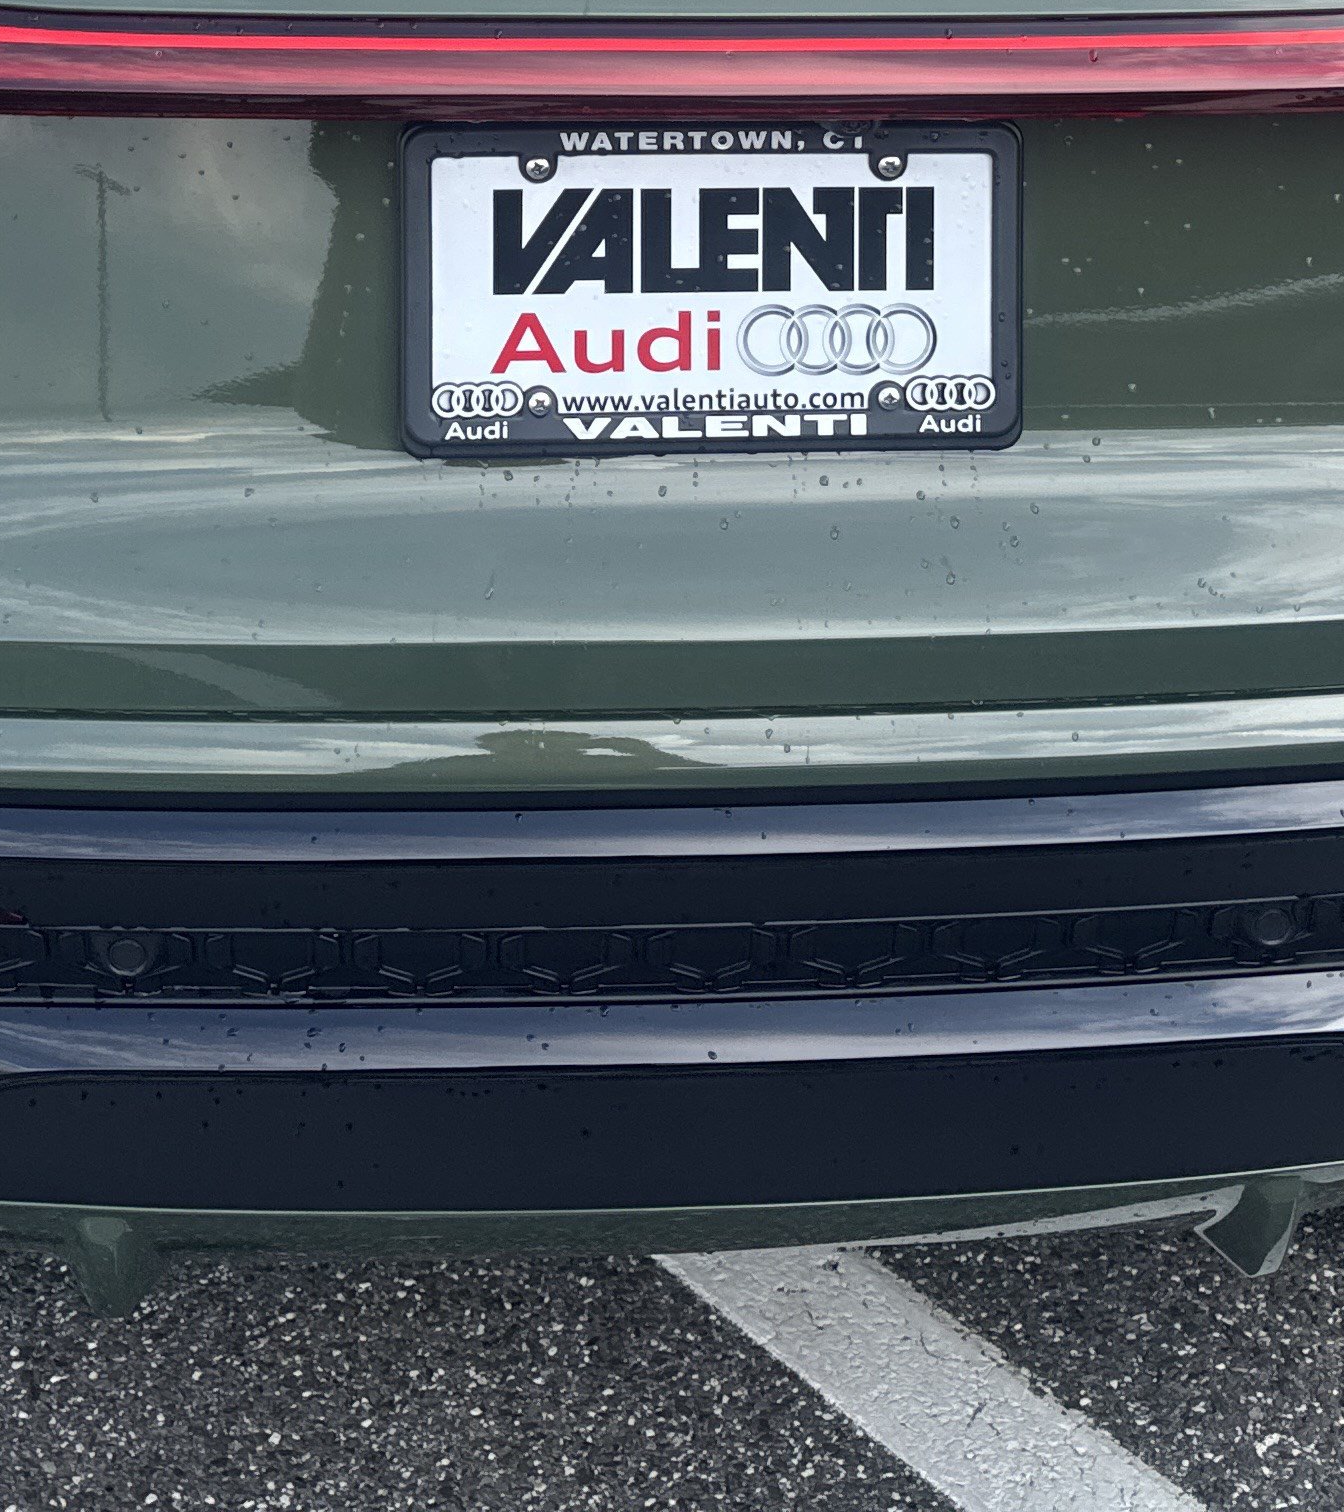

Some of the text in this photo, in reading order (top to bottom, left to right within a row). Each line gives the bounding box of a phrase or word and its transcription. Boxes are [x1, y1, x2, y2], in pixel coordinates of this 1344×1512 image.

[558, 130, 806, 152] WATERTOWN,
[493, 187, 935, 295] VALENTI
[490, 310, 722, 374] Audi
[562, 388, 866, 412] www.valentiauto.com
[444, 420, 510, 441] Audi
[562, 413, 868, 440] VALENTI
[918, 414, 982, 433] Audi
